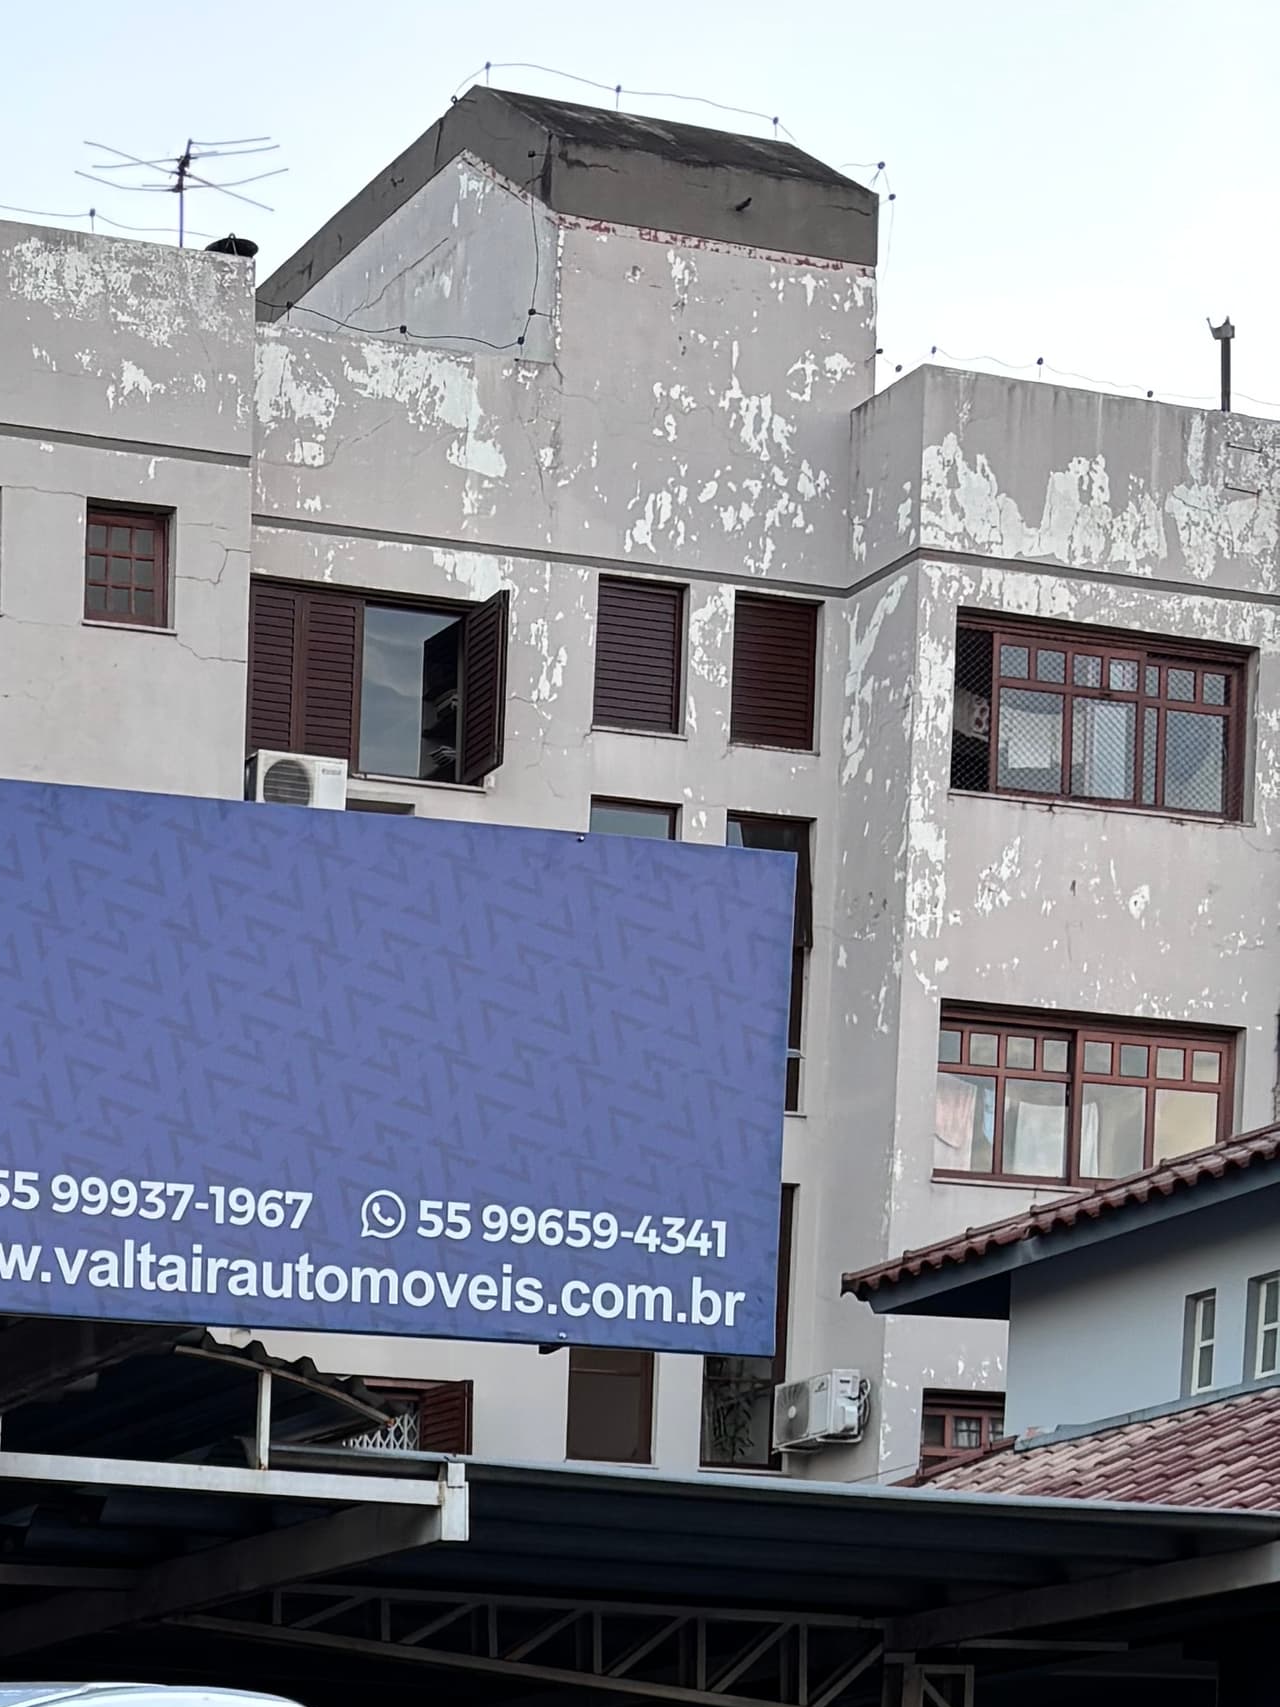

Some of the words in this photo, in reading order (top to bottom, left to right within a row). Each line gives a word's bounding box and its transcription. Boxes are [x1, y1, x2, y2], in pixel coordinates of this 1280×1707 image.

[51, 1174, 313, 1229] 99937-1967
[417, 1199, 472, 1240] 55
[482, 1204, 727, 1258] 99659-4341
